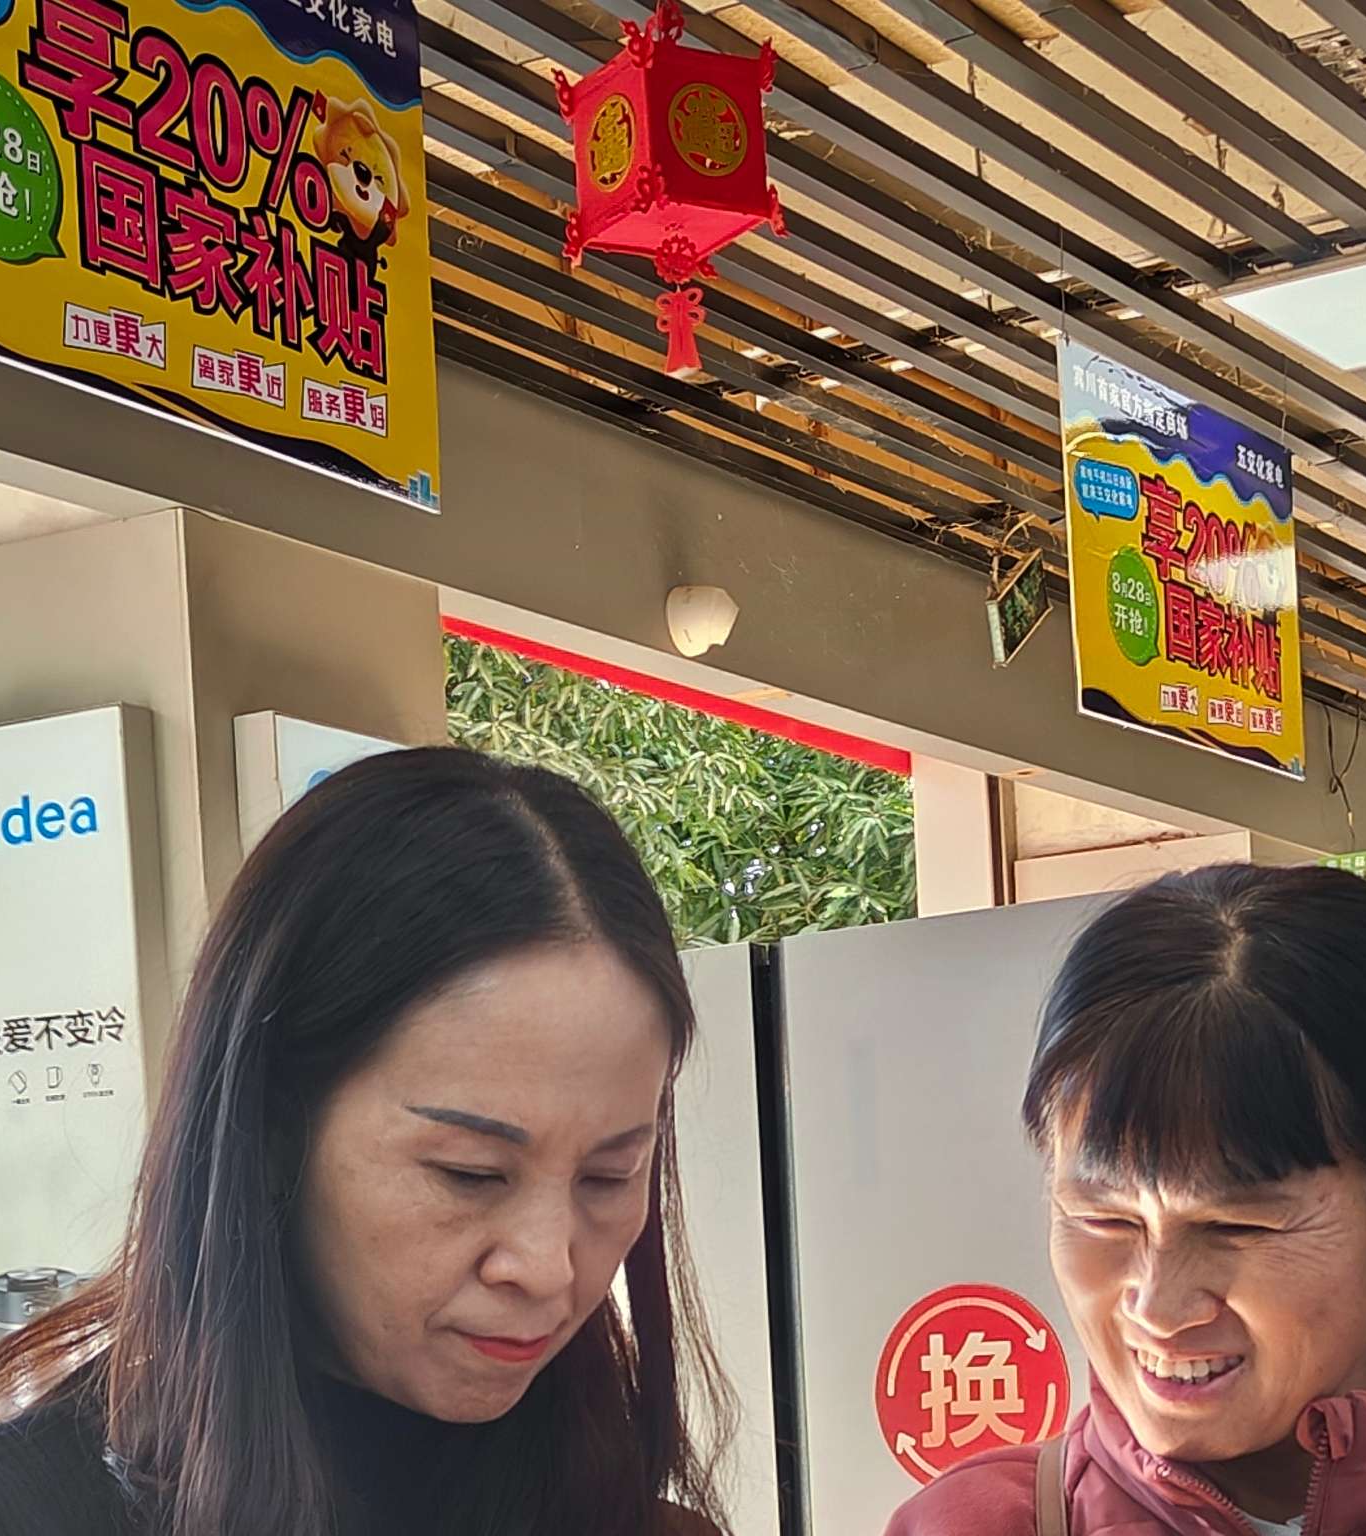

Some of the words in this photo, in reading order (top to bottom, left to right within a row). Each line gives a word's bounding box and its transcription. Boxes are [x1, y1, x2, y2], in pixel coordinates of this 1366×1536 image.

[80, 143, 388, 384] 国家补贴
[71, 313, 165, 362] 力度更大
[197, 351, 285, 400] 离家更近
[308, 386, 385, 430] 服务更好
[1112, 573, 1153, 607] 8月28日
[1165, 582, 1282, 702] 国家补贴
[920, 1332, 1025, 1448] 换
